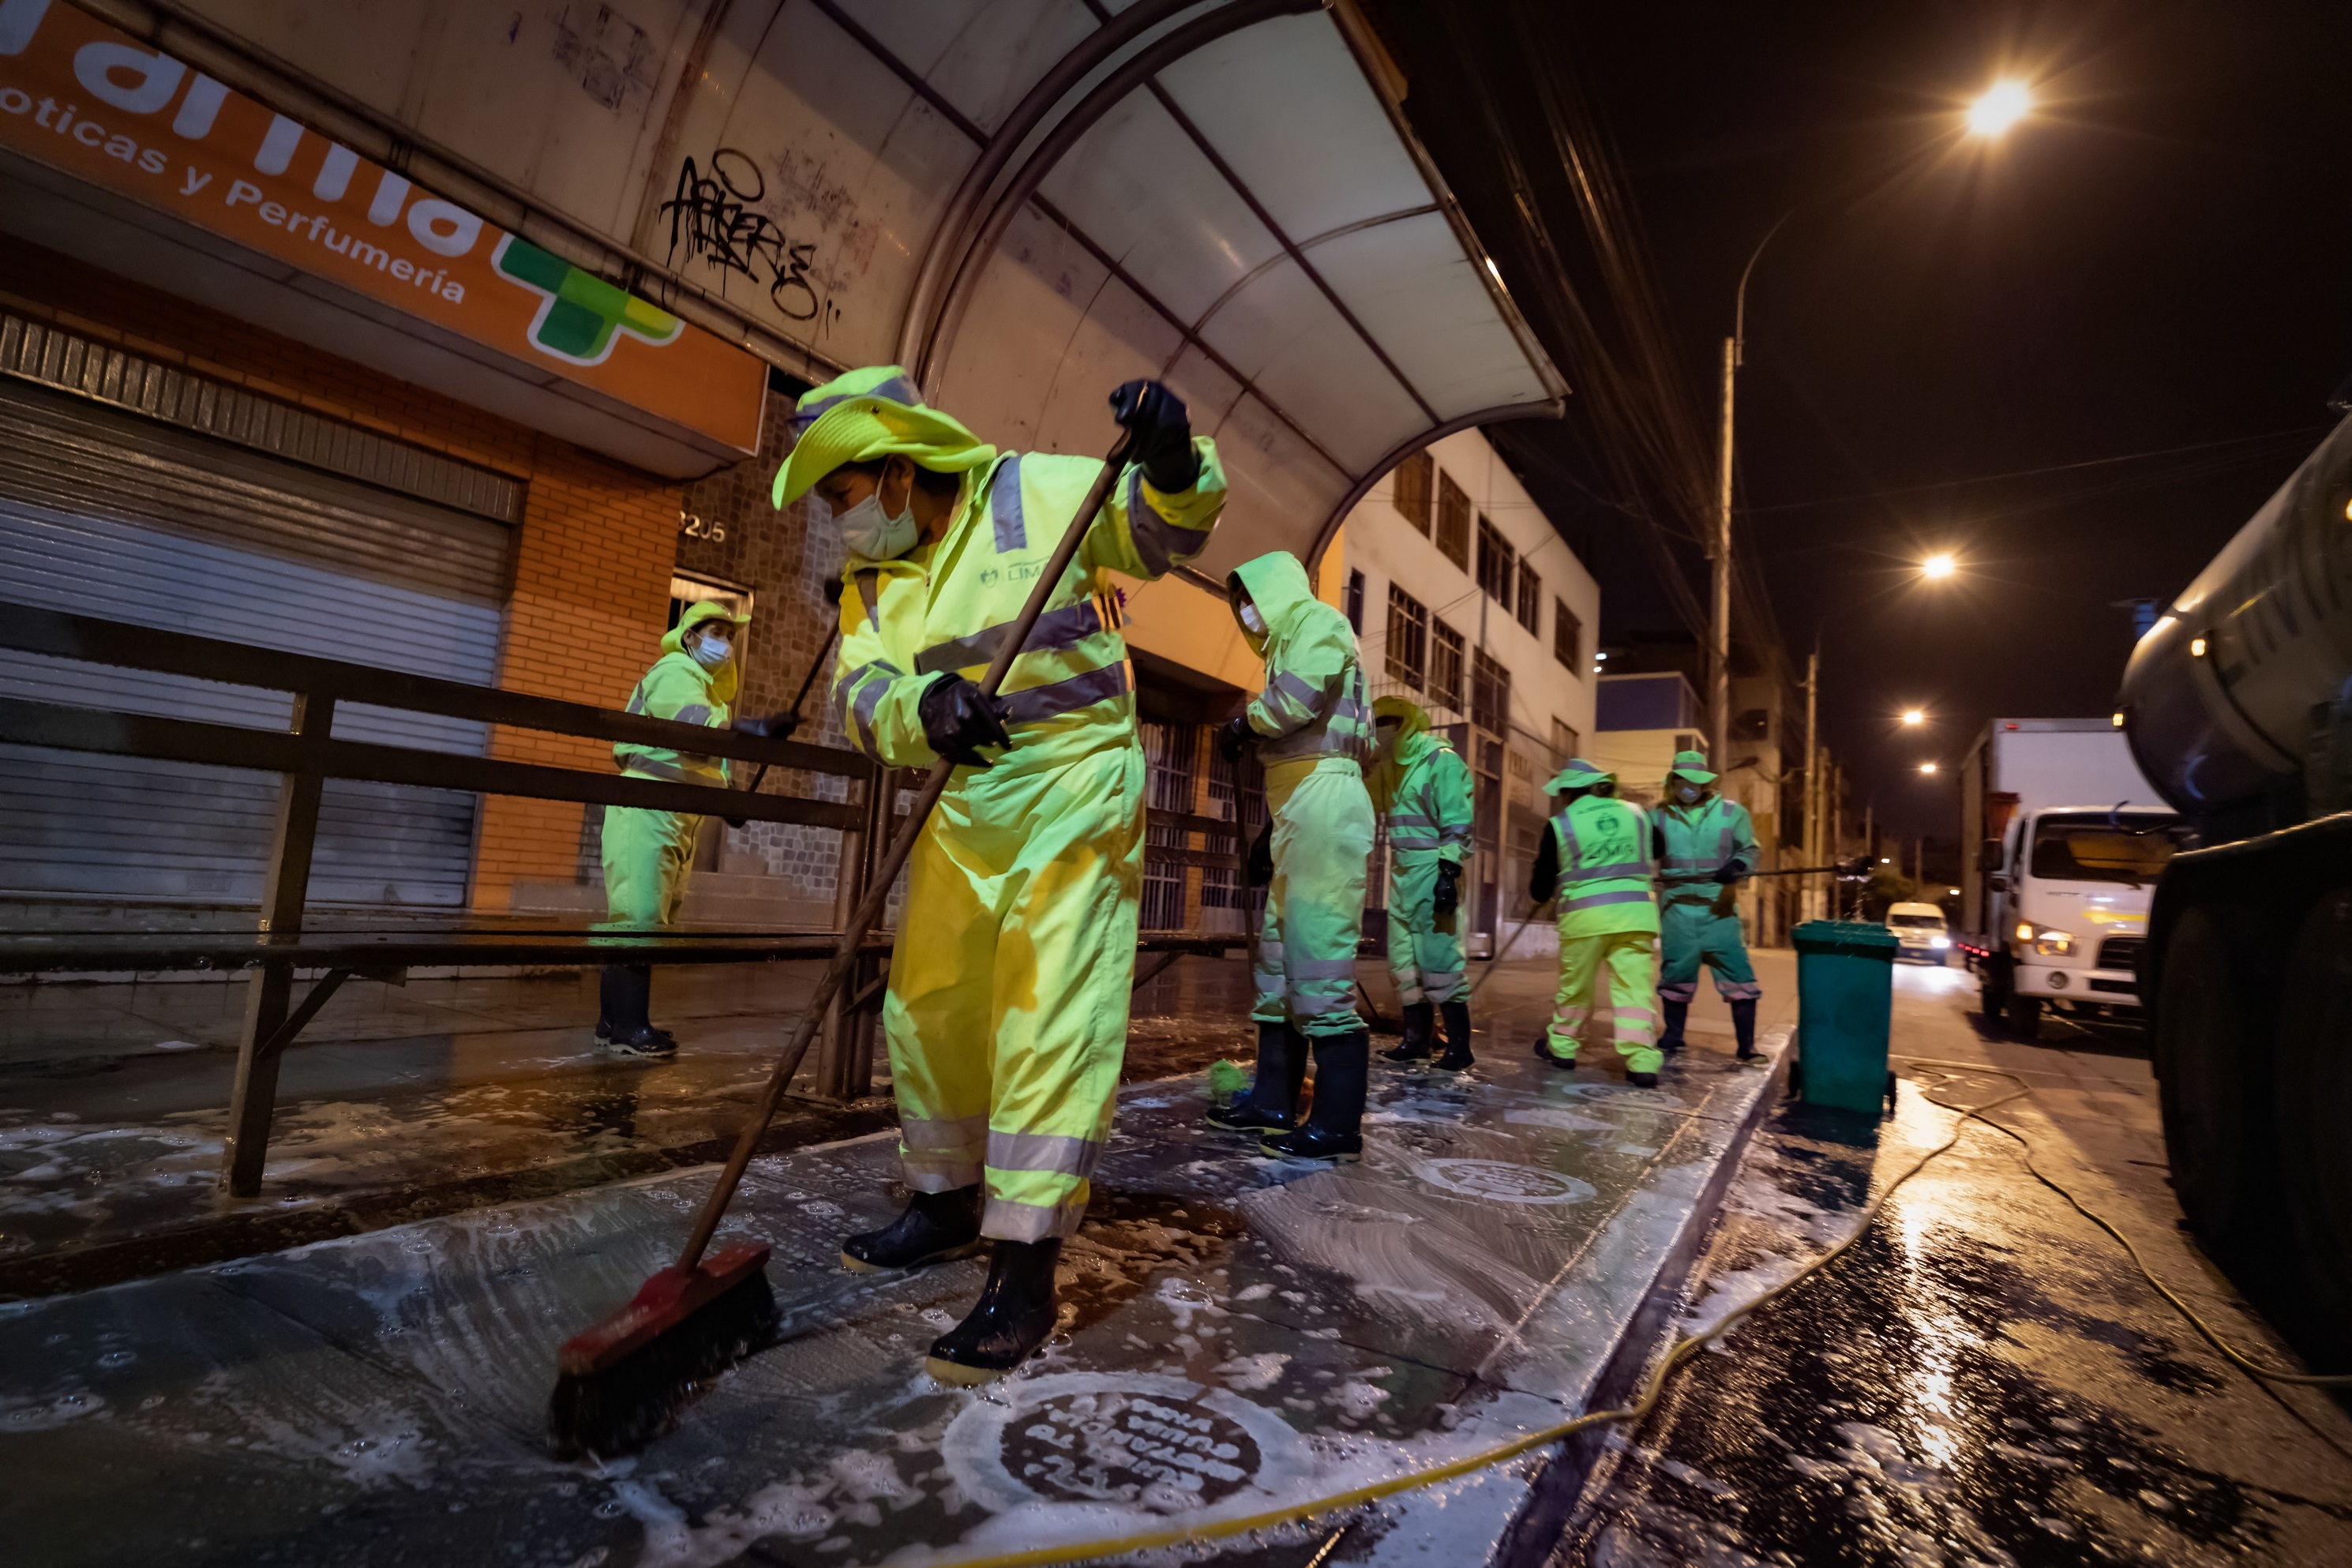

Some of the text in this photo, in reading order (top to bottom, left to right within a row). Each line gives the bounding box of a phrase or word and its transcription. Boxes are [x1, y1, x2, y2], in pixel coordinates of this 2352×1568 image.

[0, 0, 484, 257] arma
[179, 165, 213, 196] y
[225, 178, 465, 304] Perfumería
